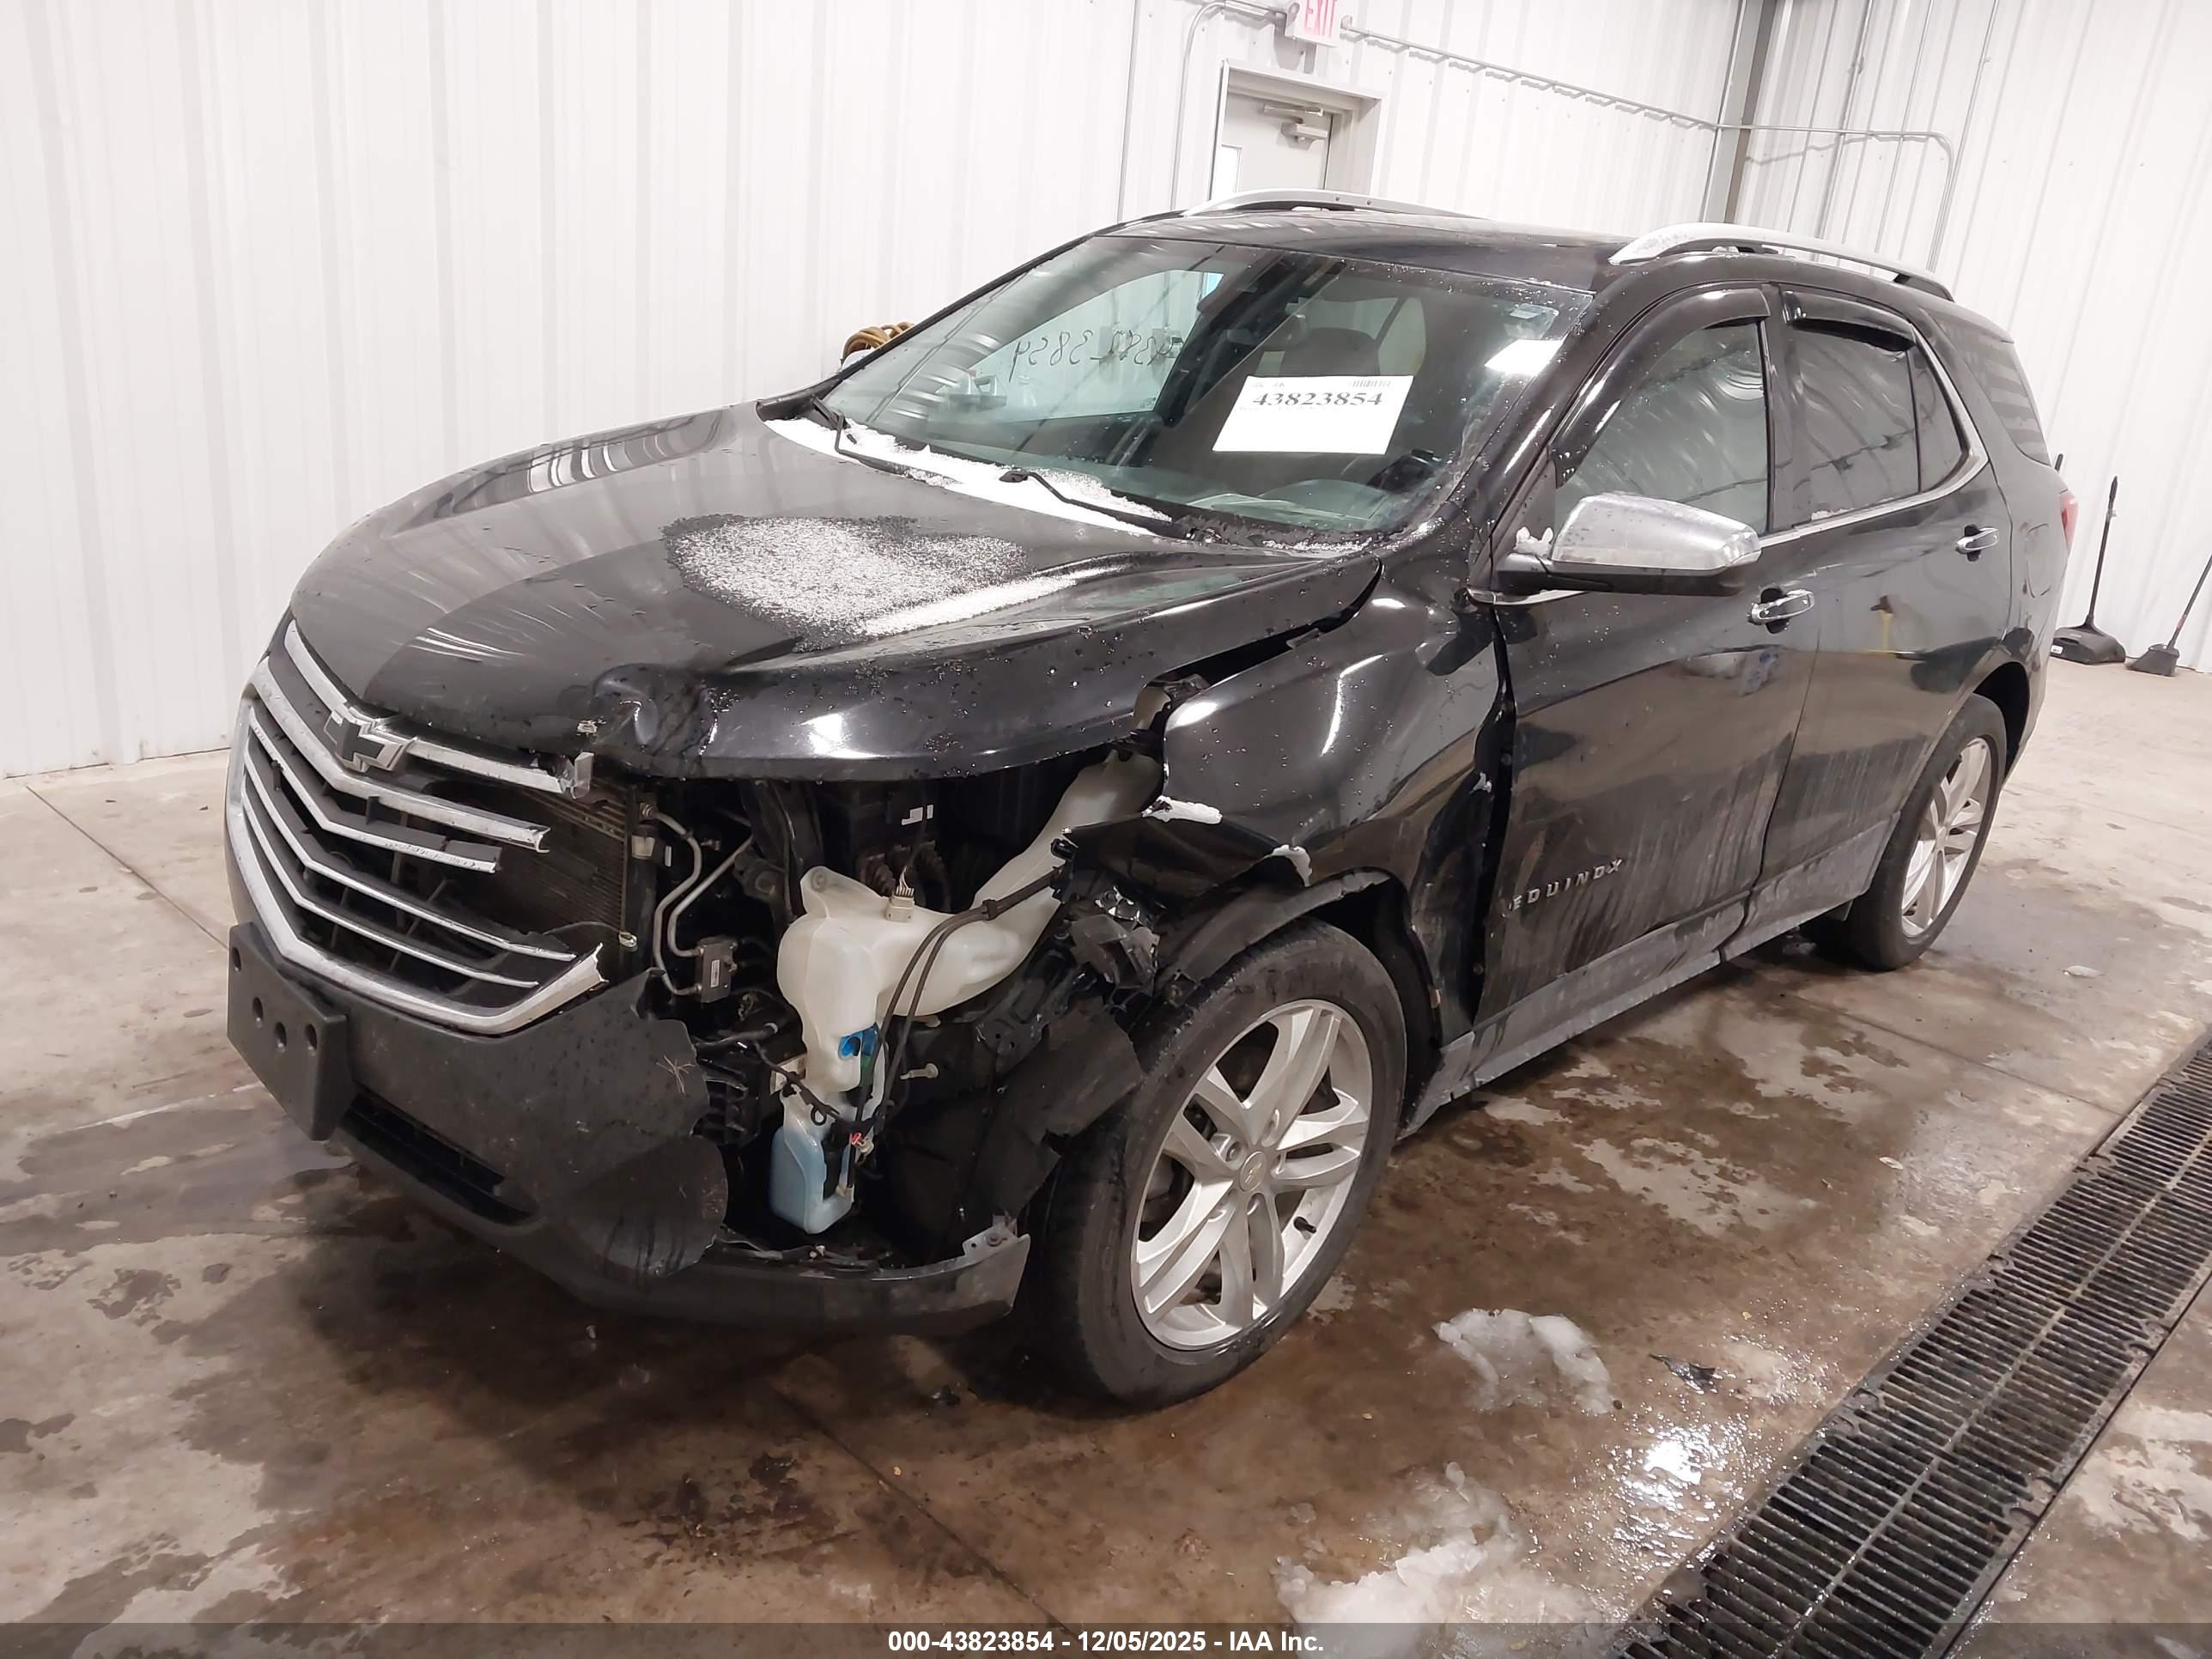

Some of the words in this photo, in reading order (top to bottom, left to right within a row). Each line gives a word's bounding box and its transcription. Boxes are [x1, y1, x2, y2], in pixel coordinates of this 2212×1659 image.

[1304, 0, 1337, 38] EXIT
[1252, 392, 1383, 406] 43823854
[1511, 859, 1622, 911] EQUINOX
